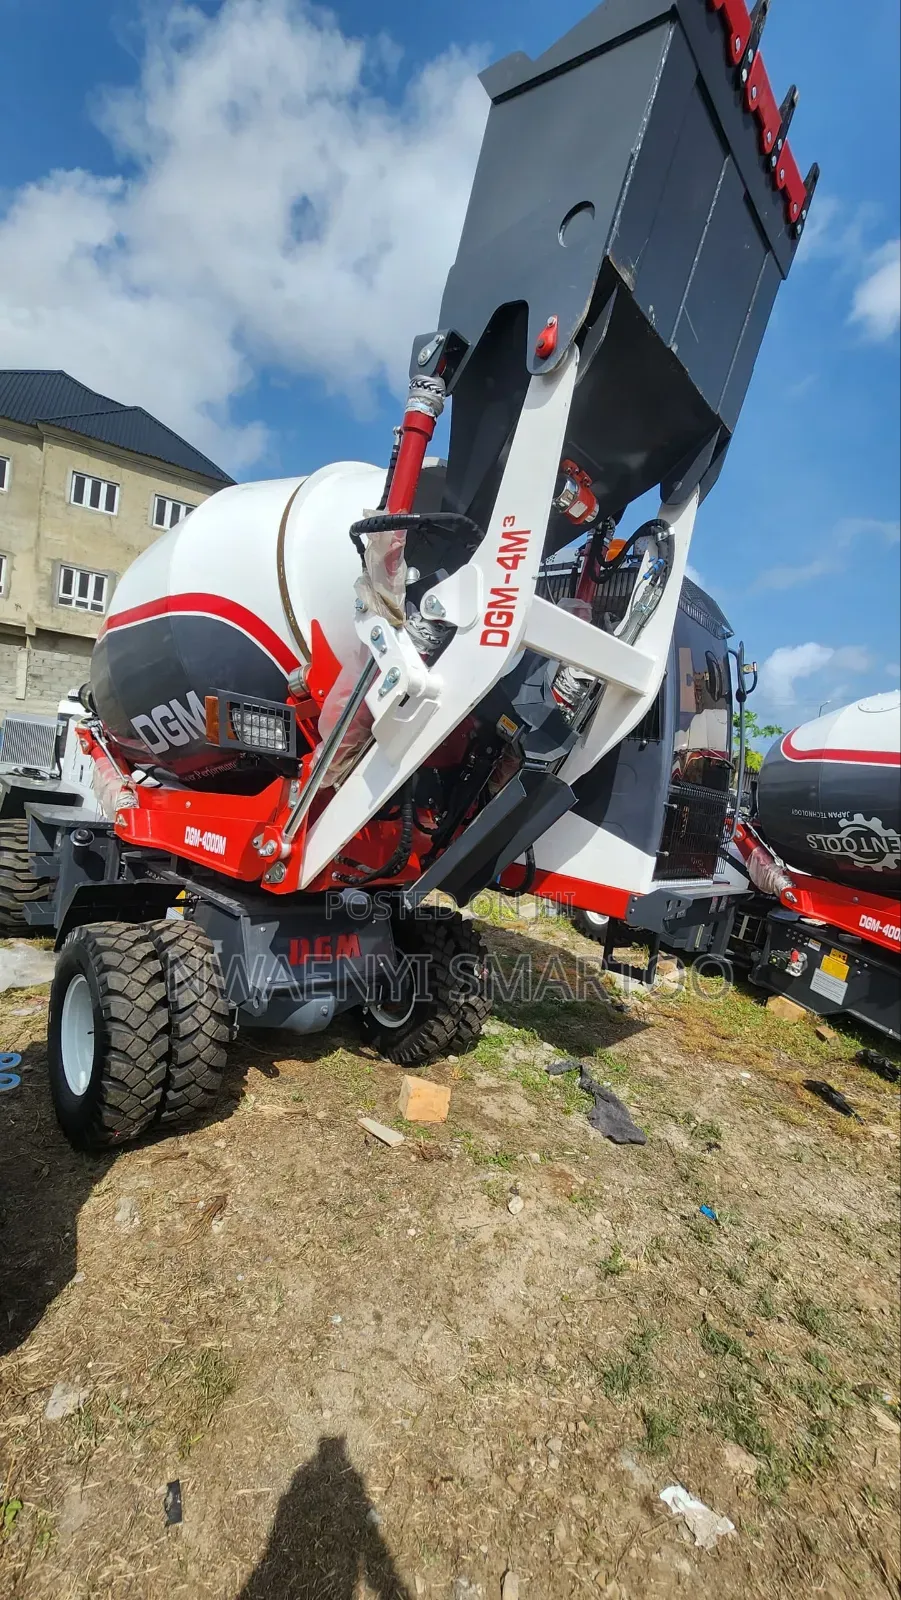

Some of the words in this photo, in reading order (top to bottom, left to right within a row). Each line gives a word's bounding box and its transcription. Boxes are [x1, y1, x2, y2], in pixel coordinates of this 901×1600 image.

[130, 690, 207, 755] DGM
[791, 808, 828, 819] TECHNOLOGY
[828, 810, 851, 819] JAPAN
[184, 825, 227, 856] DGM-4000M
[858, 914, 901, 942] DGM-400
[289, 934, 362, 966] DGM
